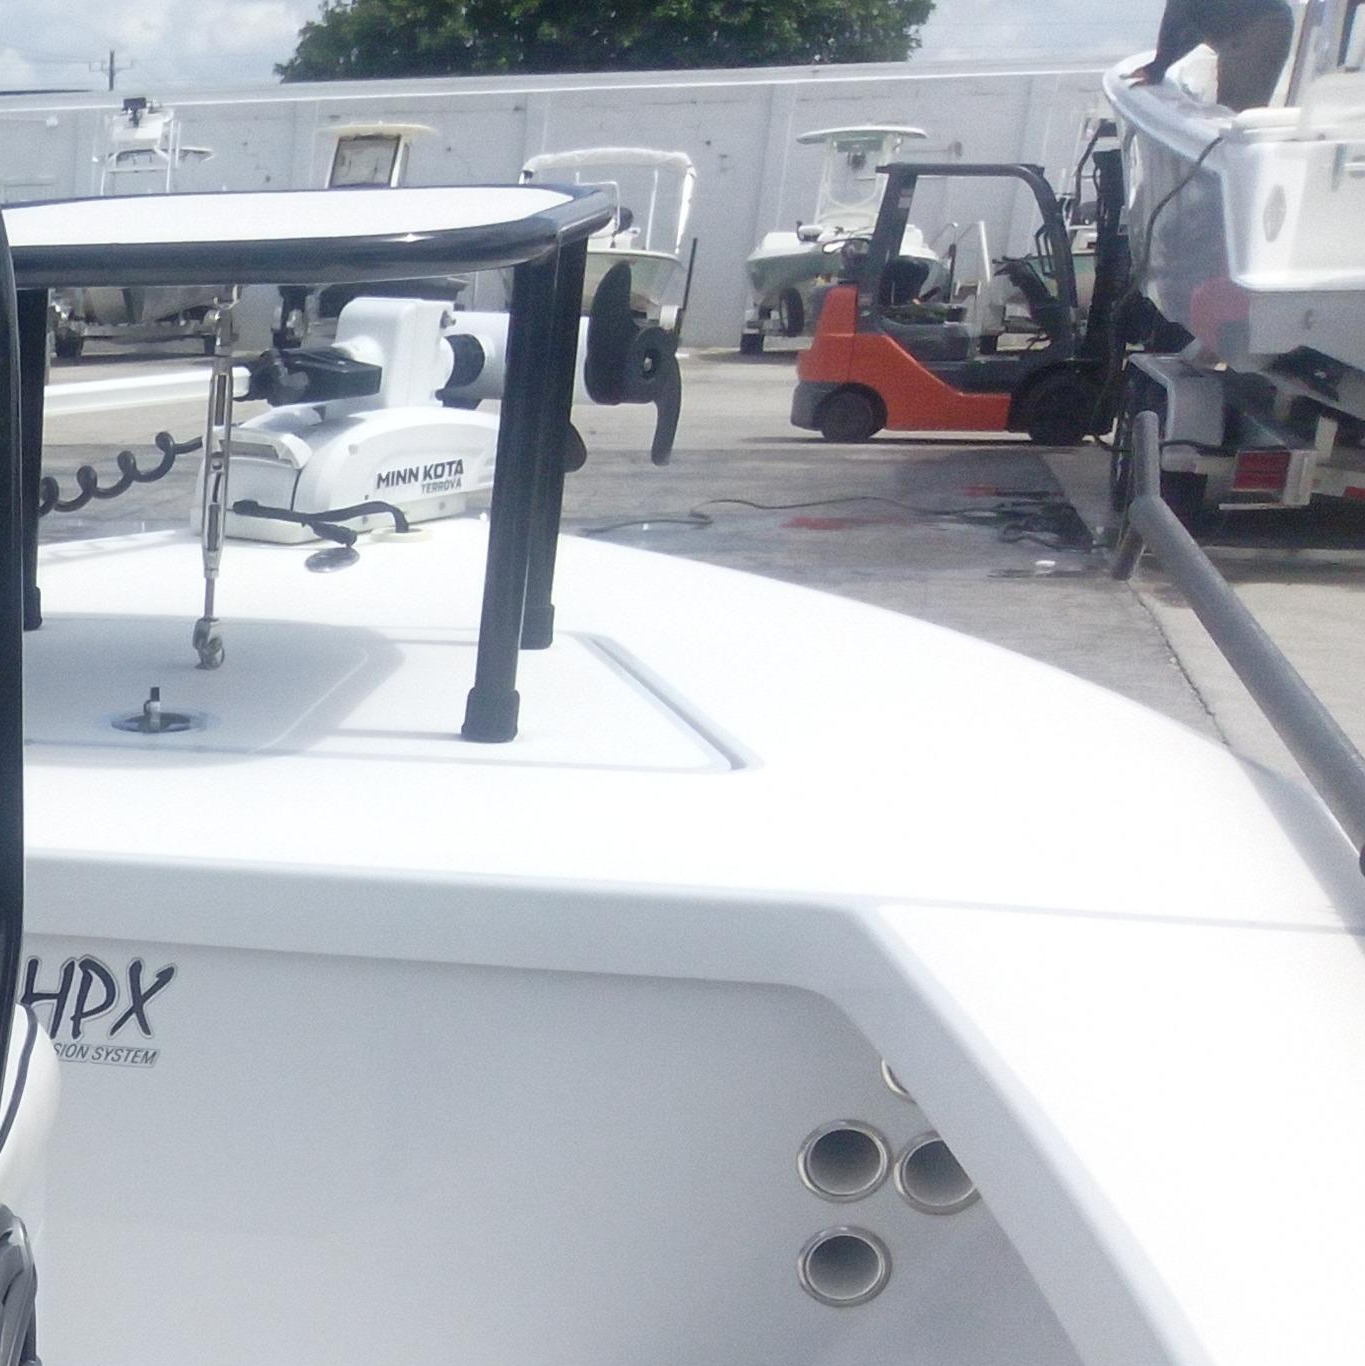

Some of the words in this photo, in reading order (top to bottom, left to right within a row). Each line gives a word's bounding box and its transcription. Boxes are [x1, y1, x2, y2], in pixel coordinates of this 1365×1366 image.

[376, 466, 420, 489] MINN
[422, 459, 464, 481] KOTA
[20, 958, 175, 1040] HPX
[91, 1046, 158, 1065] SYSTEM
